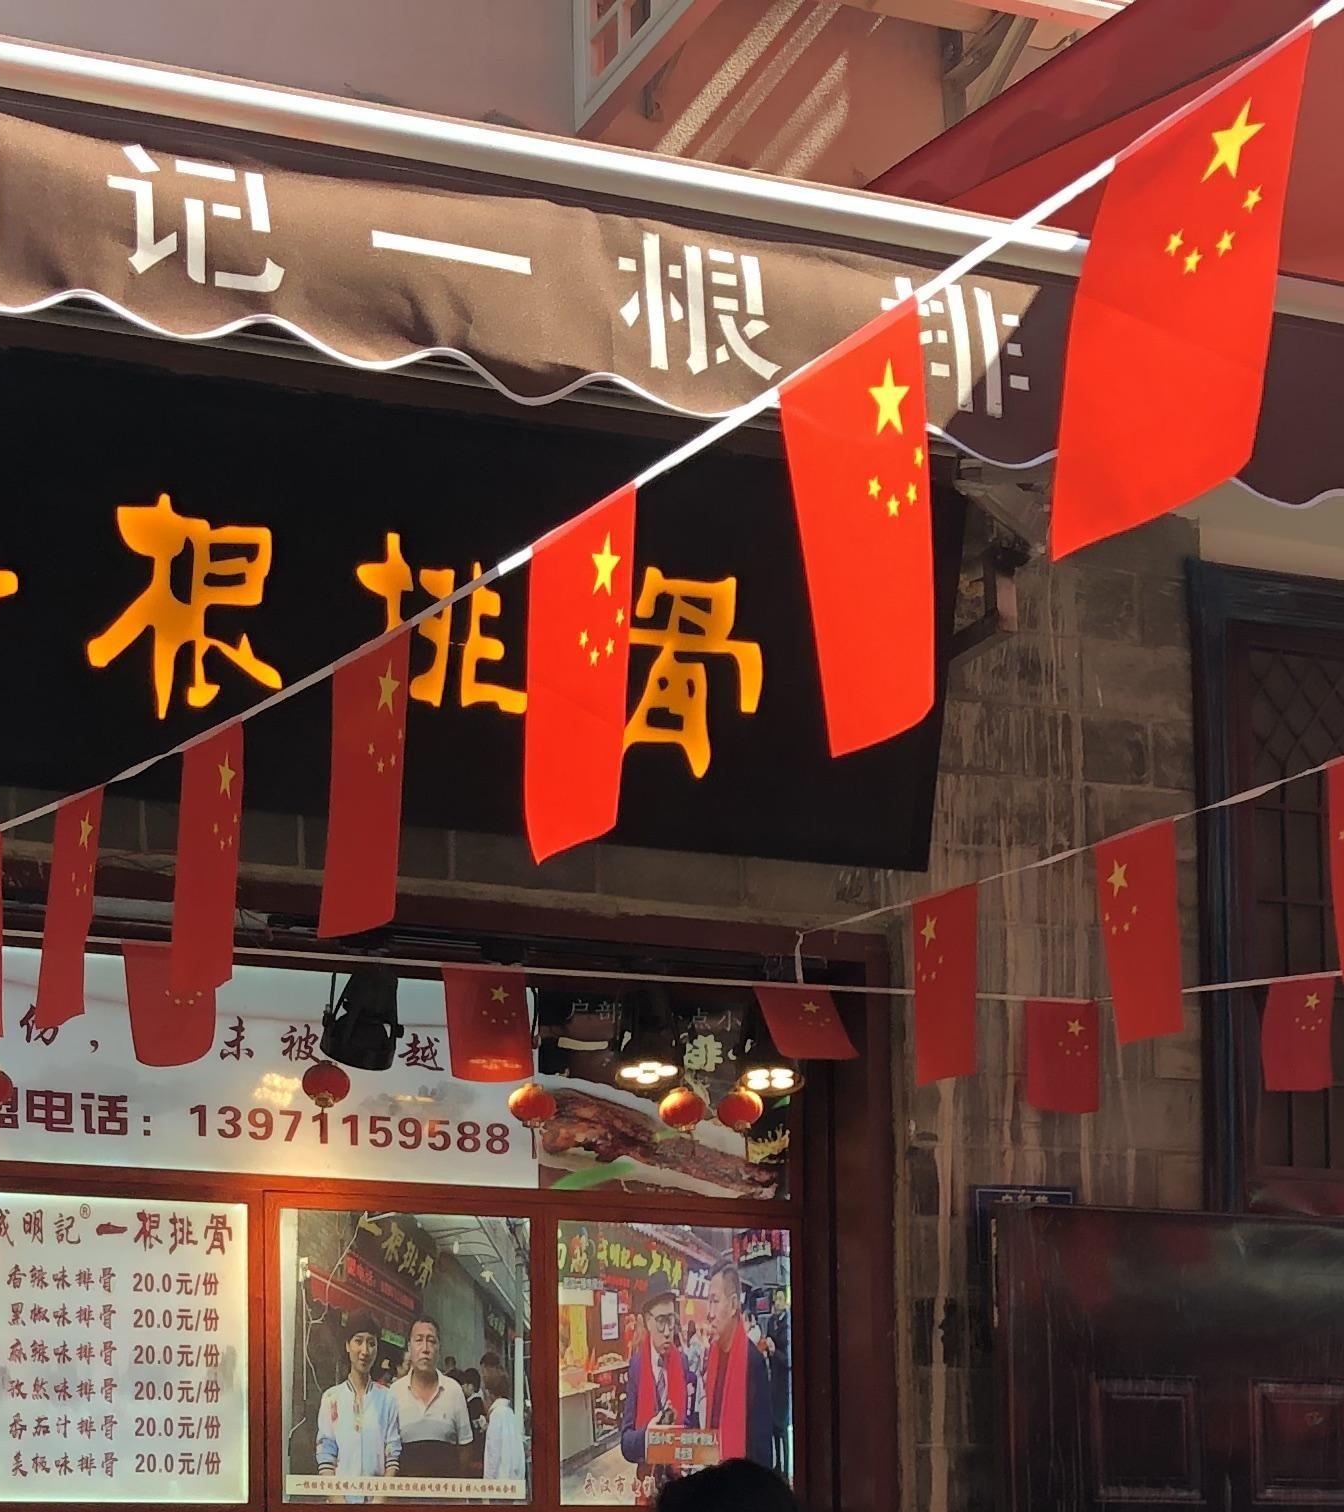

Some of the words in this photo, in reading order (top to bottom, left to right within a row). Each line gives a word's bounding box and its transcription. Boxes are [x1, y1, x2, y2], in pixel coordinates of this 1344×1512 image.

[190, 1104, 510, 1155] 13971159588
[6, 1264, 117, 1293] 香辣味排骨
[132, 1272, 220, 1296] 20.0元/份
[7, 1301, 117, 1330] 黑椒味排骨
[132, 1308, 220, 1332] 20.0元/份
[133, 1343, 220, 1368] 20.0元/份
[7, 1376, 118, 1404] 孜然味排骨
[134, 1381, 221, 1404] 20.0元/份
[134, 1415, 221, 1440] 20.0元/份
[134, 1451, 221, 1476] 20.0元/份
